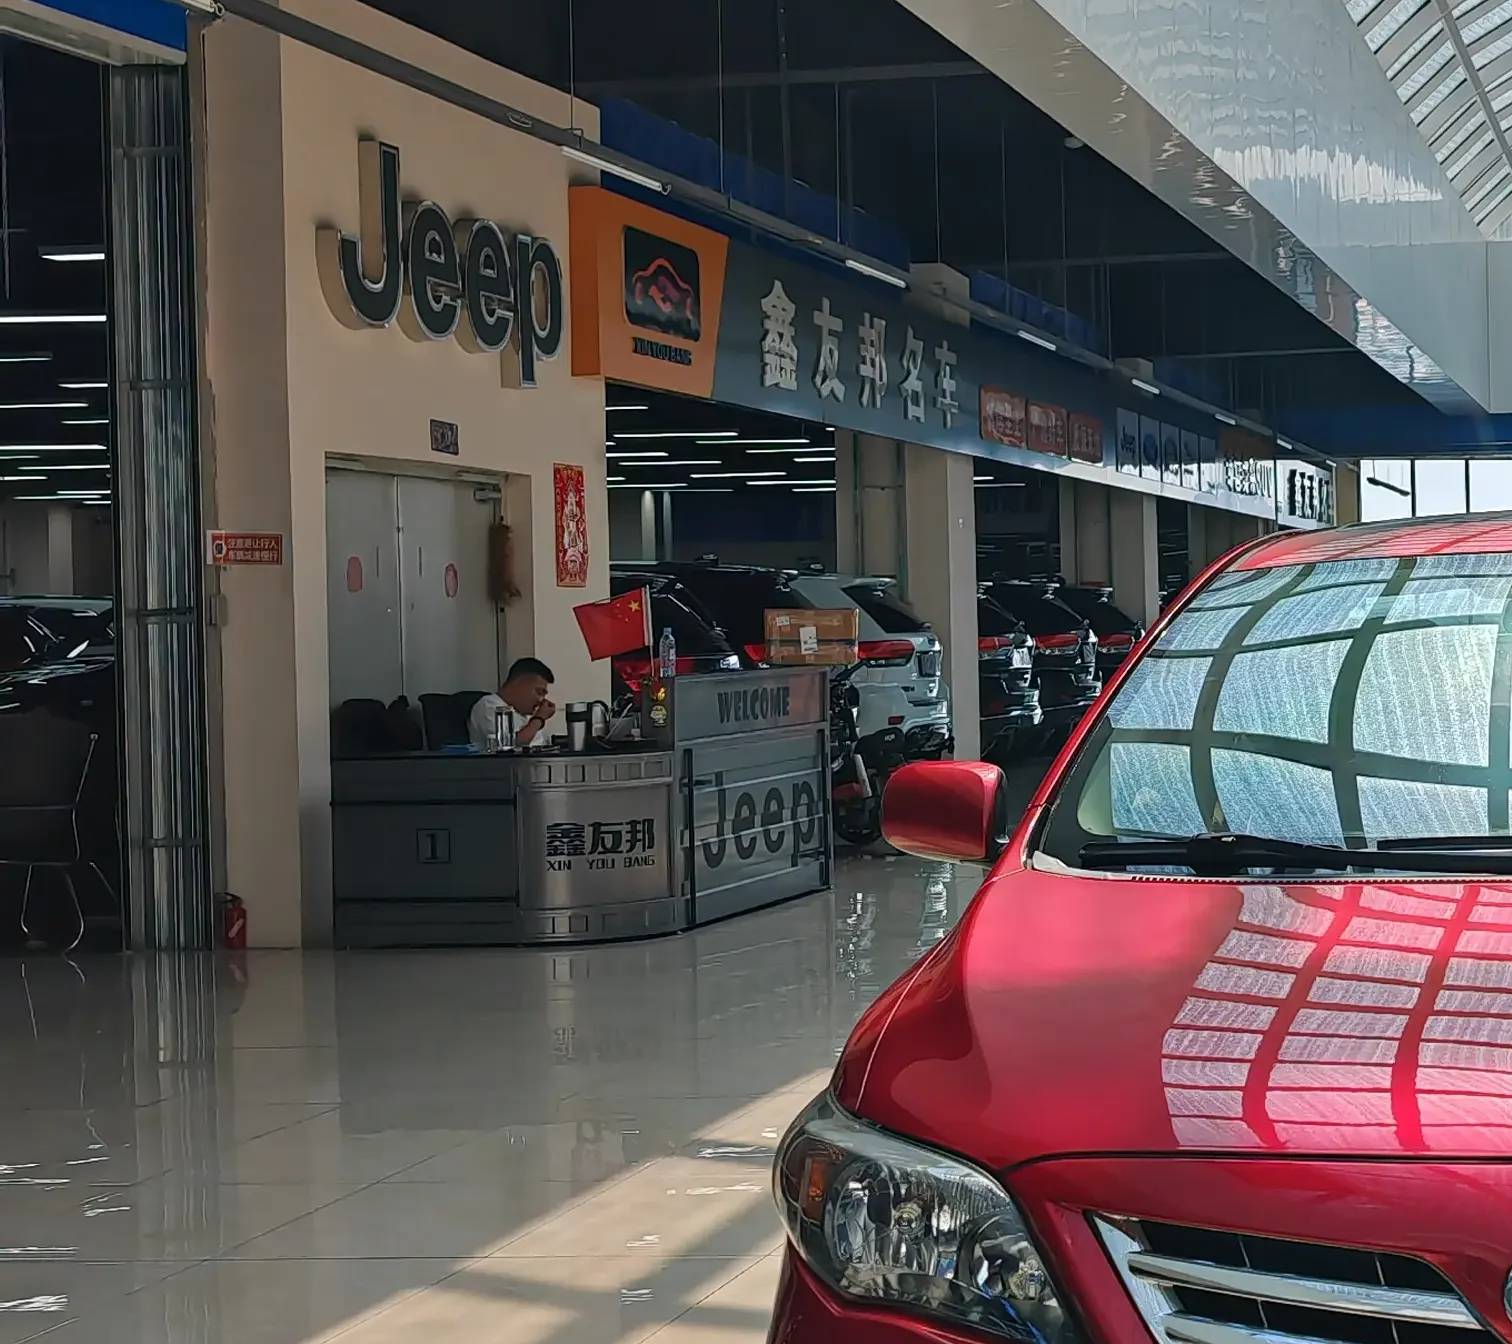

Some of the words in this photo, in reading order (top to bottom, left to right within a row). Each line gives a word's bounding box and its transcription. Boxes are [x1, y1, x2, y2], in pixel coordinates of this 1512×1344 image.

[322, 140, 564, 389] Jeep
[760, 278, 958, 429] 鑫友邦名车
[717, 686, 790, 724] WELCOME
[546, 818, 656, 857] 鑫友邦
[702, 771, 816, 869] Jeep
[425, 832, 439, 861] 1
[546, 859, 572, 872] XIN
[587, 858, 616, 870] YOU
[624, 855, 656, 868] BANG
